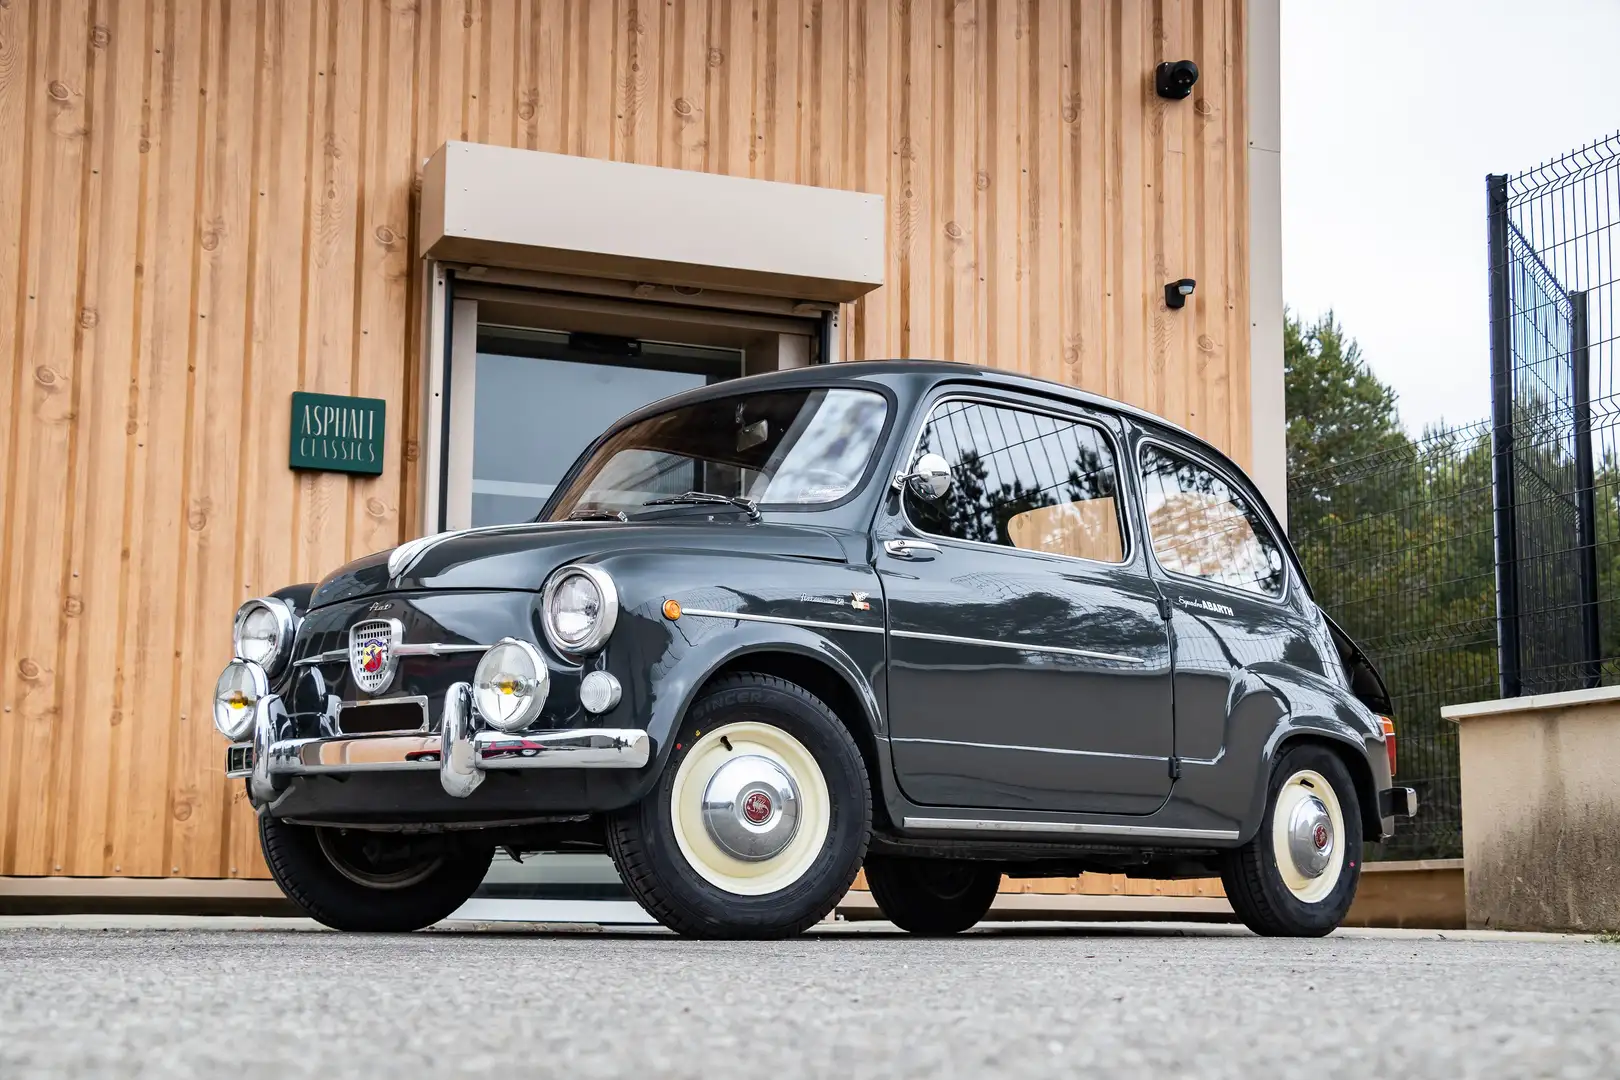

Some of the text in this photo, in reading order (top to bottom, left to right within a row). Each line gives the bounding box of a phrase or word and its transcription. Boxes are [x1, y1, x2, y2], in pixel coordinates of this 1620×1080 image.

[301, 404, 376, 440] ASPHALT
[300, 438, 375, 462] CLASSICS
[1201, 600, 1235, 617] ABARTH
